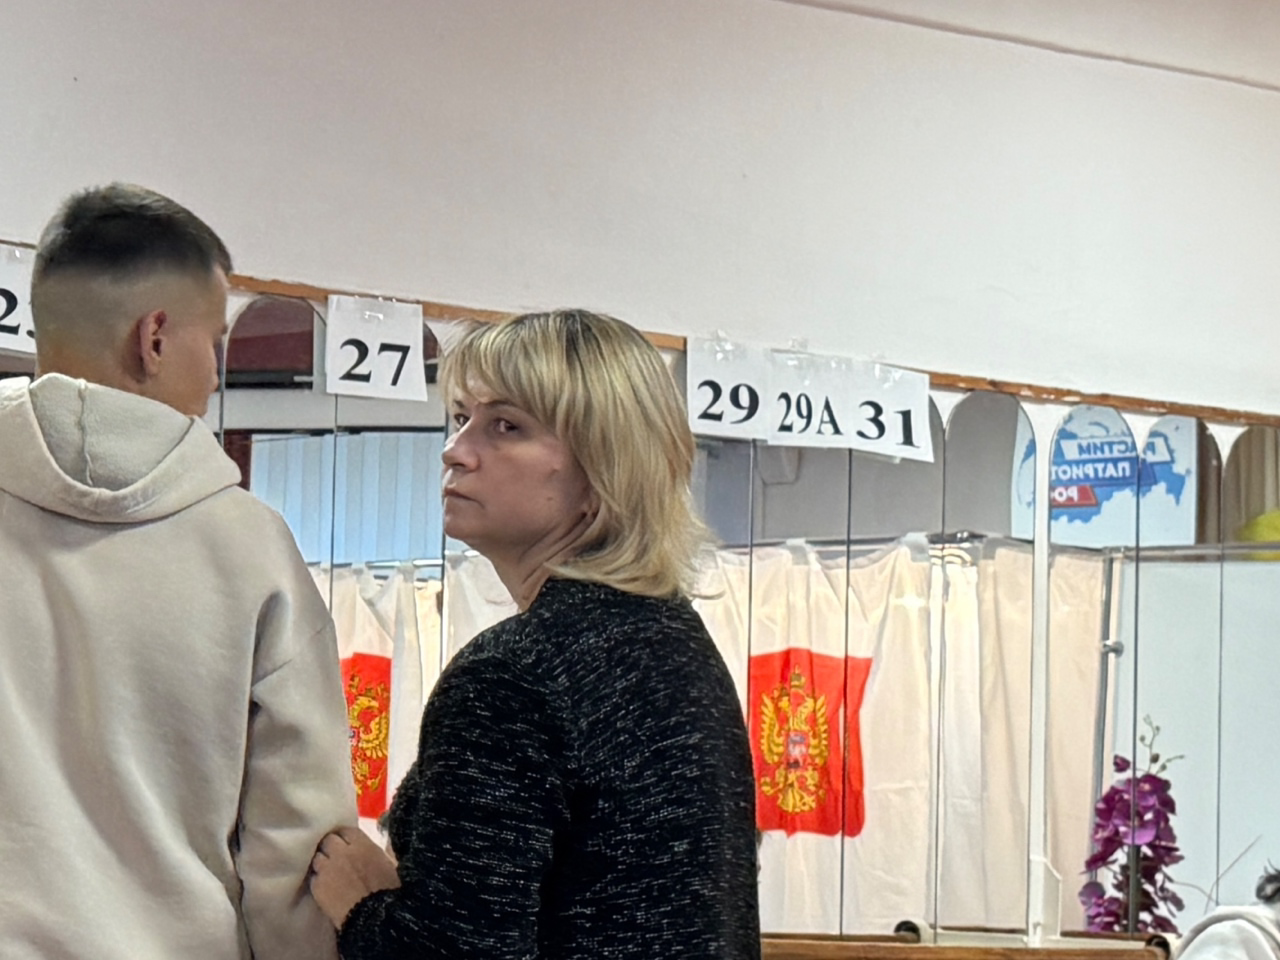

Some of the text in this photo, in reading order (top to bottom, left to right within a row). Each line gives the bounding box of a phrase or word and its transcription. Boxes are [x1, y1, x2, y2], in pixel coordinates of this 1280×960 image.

[338, 337, 411, 386] 27
[696, 379, 760, 424] 29
[776, 391, 844, 436] 29А
[855, 400, 921, 448] 31
